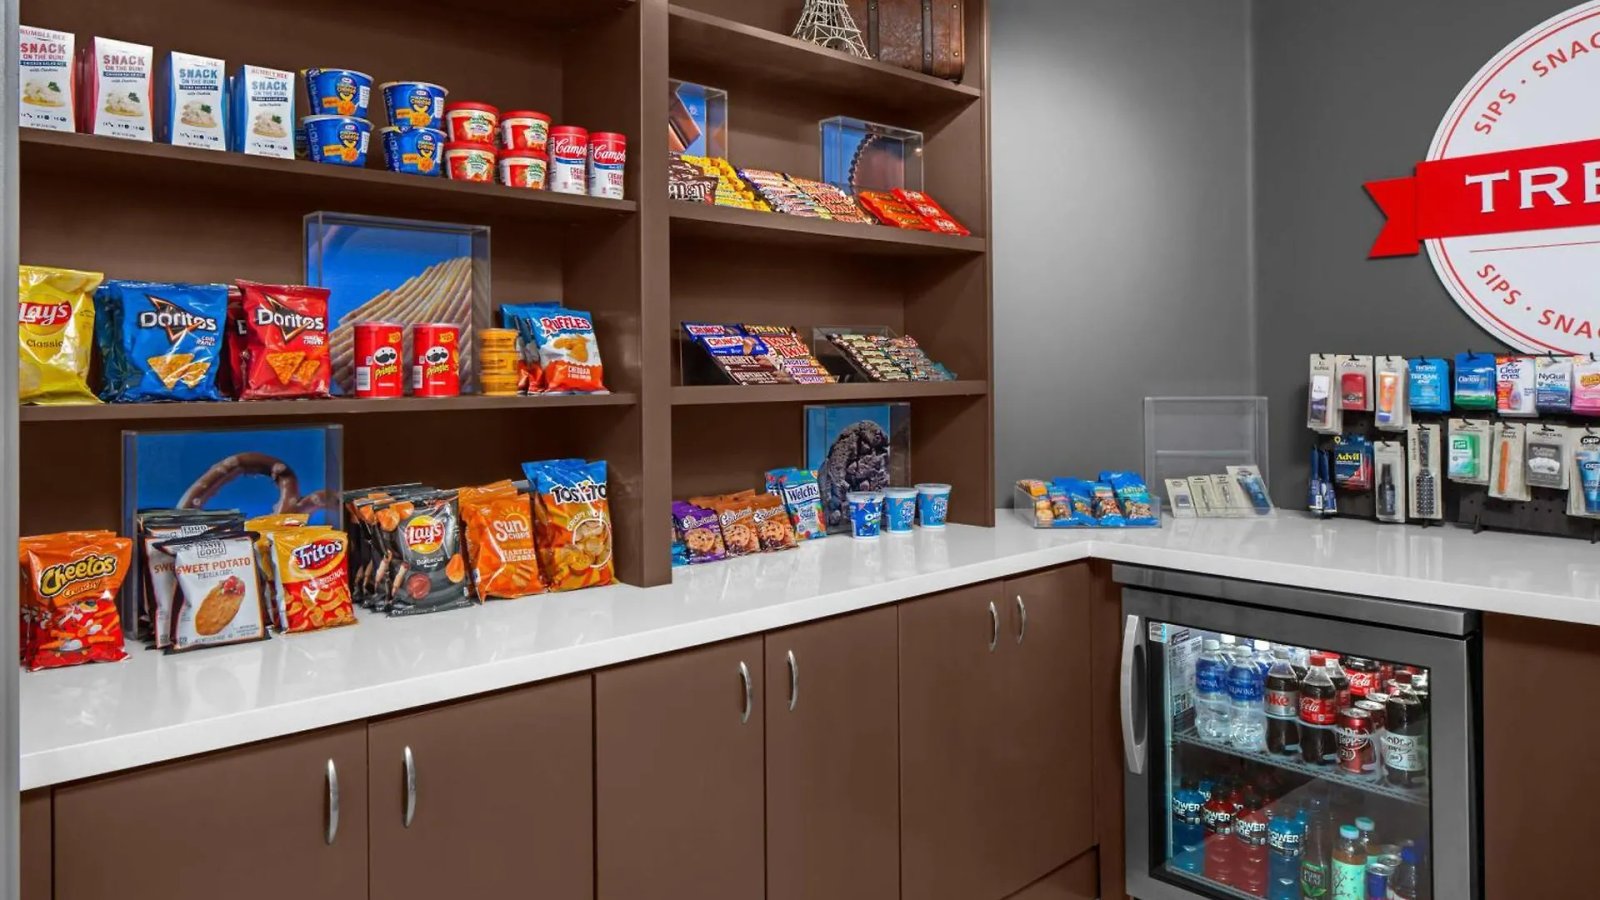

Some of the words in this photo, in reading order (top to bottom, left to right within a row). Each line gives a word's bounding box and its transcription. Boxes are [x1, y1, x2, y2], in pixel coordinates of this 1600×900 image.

[20, 43, 66, 55] SNACK
[104, 54, 145, 66] SNACK
[179, 68, 218, 79] SNACK
[252, 80, 288, 91] SNACK
[1474, 88, 1517, 135] SIPS
[1476, 264, 1522, 305] SIPS
[1537, 309, 1600, 340] SNA
[19, 302, 70, 326] Lay's
[256, 308, 326, 331] Doritos
[139, 311, 218, 333] Doritos
[542, 317, 593, 337] RUFFLES
[690, 325, 725, 335] CRUNCH
[26, 339, 64, 349] Classic
[708, 336, 745, 347] CRUNCH
[1499, 367, 1521, 375] Clear
[1538, 372, 1566, 381] NyQuil
[1500, 373, 1520, 382] eyes
[1336, 453, 1360, 462] Advil
[788, 485, 820, 502] Welch's
[407, 521, 442, 545] Lay's
[493, 519, 529, 542] Sun
[292, 538, 344, 570] Fritos
[176, 563, 210, 576] SWEET
[212, 557, 251, 571] POTATO
[40, 554, 117, 597] Cheetos
[1237, 820, 1266, 832] OWER
[1270, 831, 1299, 843] OWER
